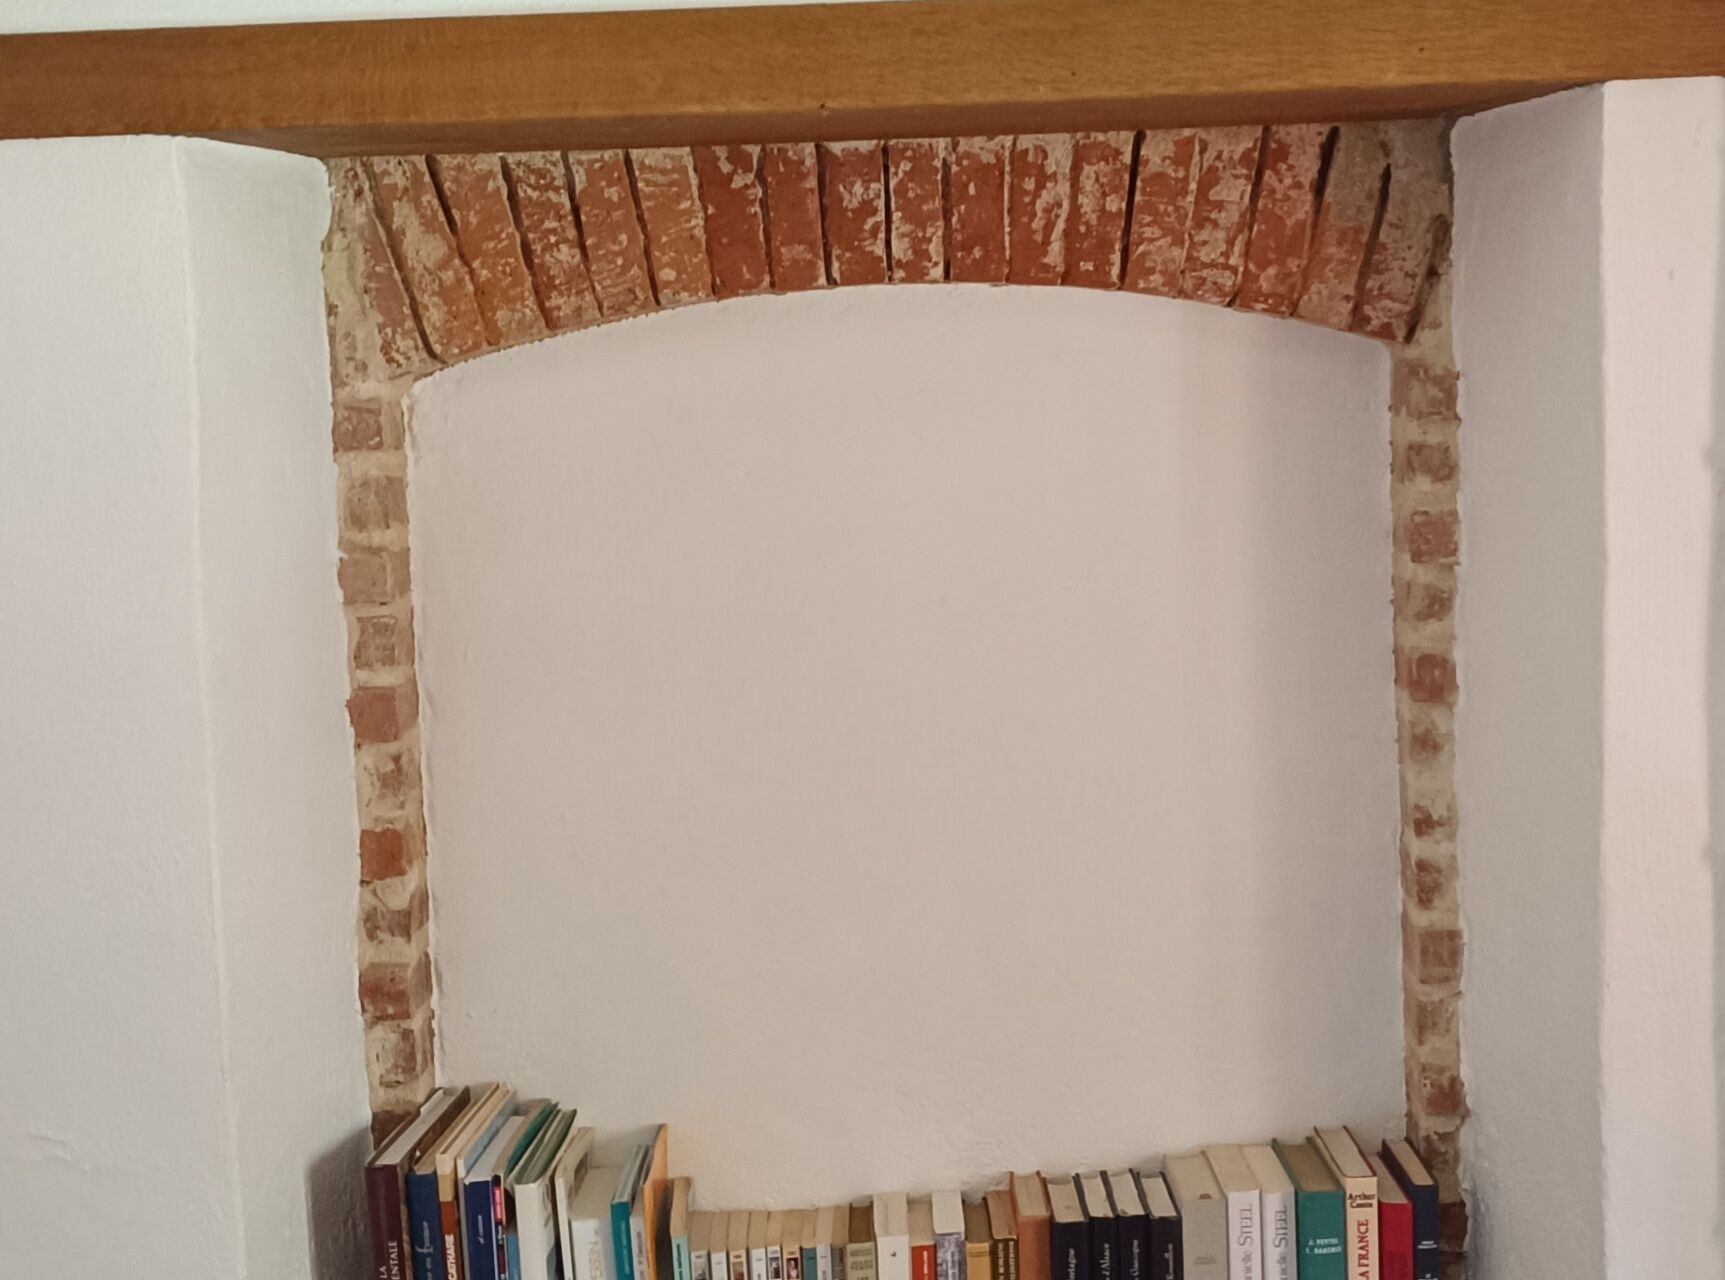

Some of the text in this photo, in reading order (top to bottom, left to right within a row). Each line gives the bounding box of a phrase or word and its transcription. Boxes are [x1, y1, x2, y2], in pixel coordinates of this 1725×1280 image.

[1236, 1203, 1254, 1247] STEEL
[1272, 1204, 1288, 1249] STEEL
[1356, 1219, 1369, 1268] FRANCE
